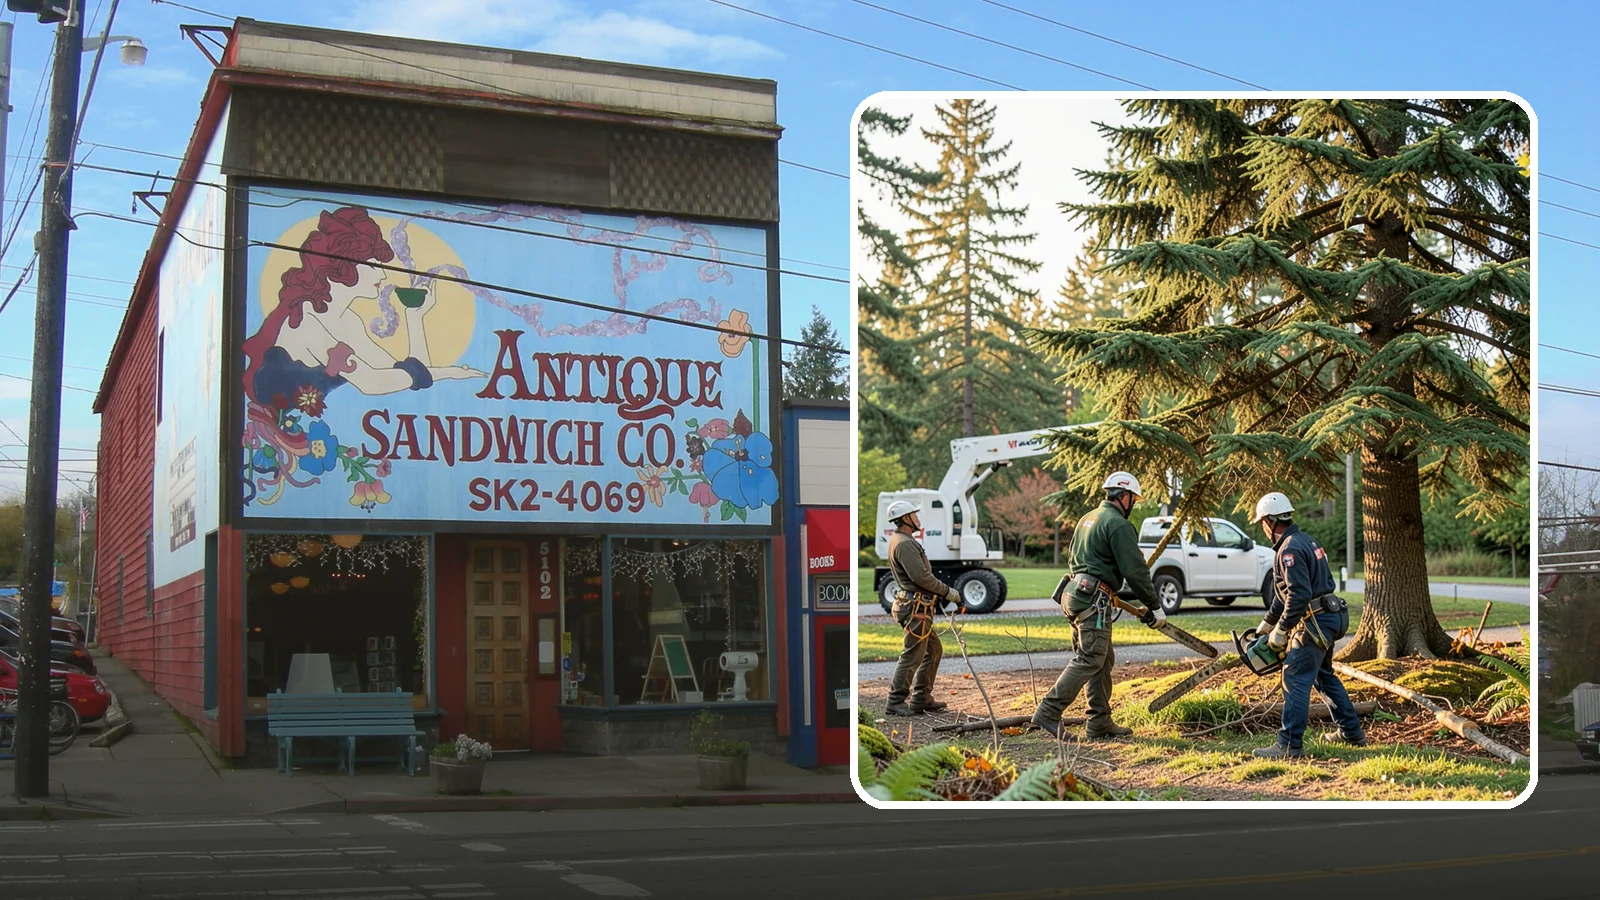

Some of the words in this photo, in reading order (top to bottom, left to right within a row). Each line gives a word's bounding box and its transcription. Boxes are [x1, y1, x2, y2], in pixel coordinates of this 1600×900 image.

[476, 328, 723, 421] ANTIQUE
[361, 409, 604, 467] SANDWICH
[617, 421, 685, 468] CO.
[468, 477, 646, 513] SK2-4069
[540, 541, 551, 599] 5102
[809, 555, 835, 569] BOOKS
